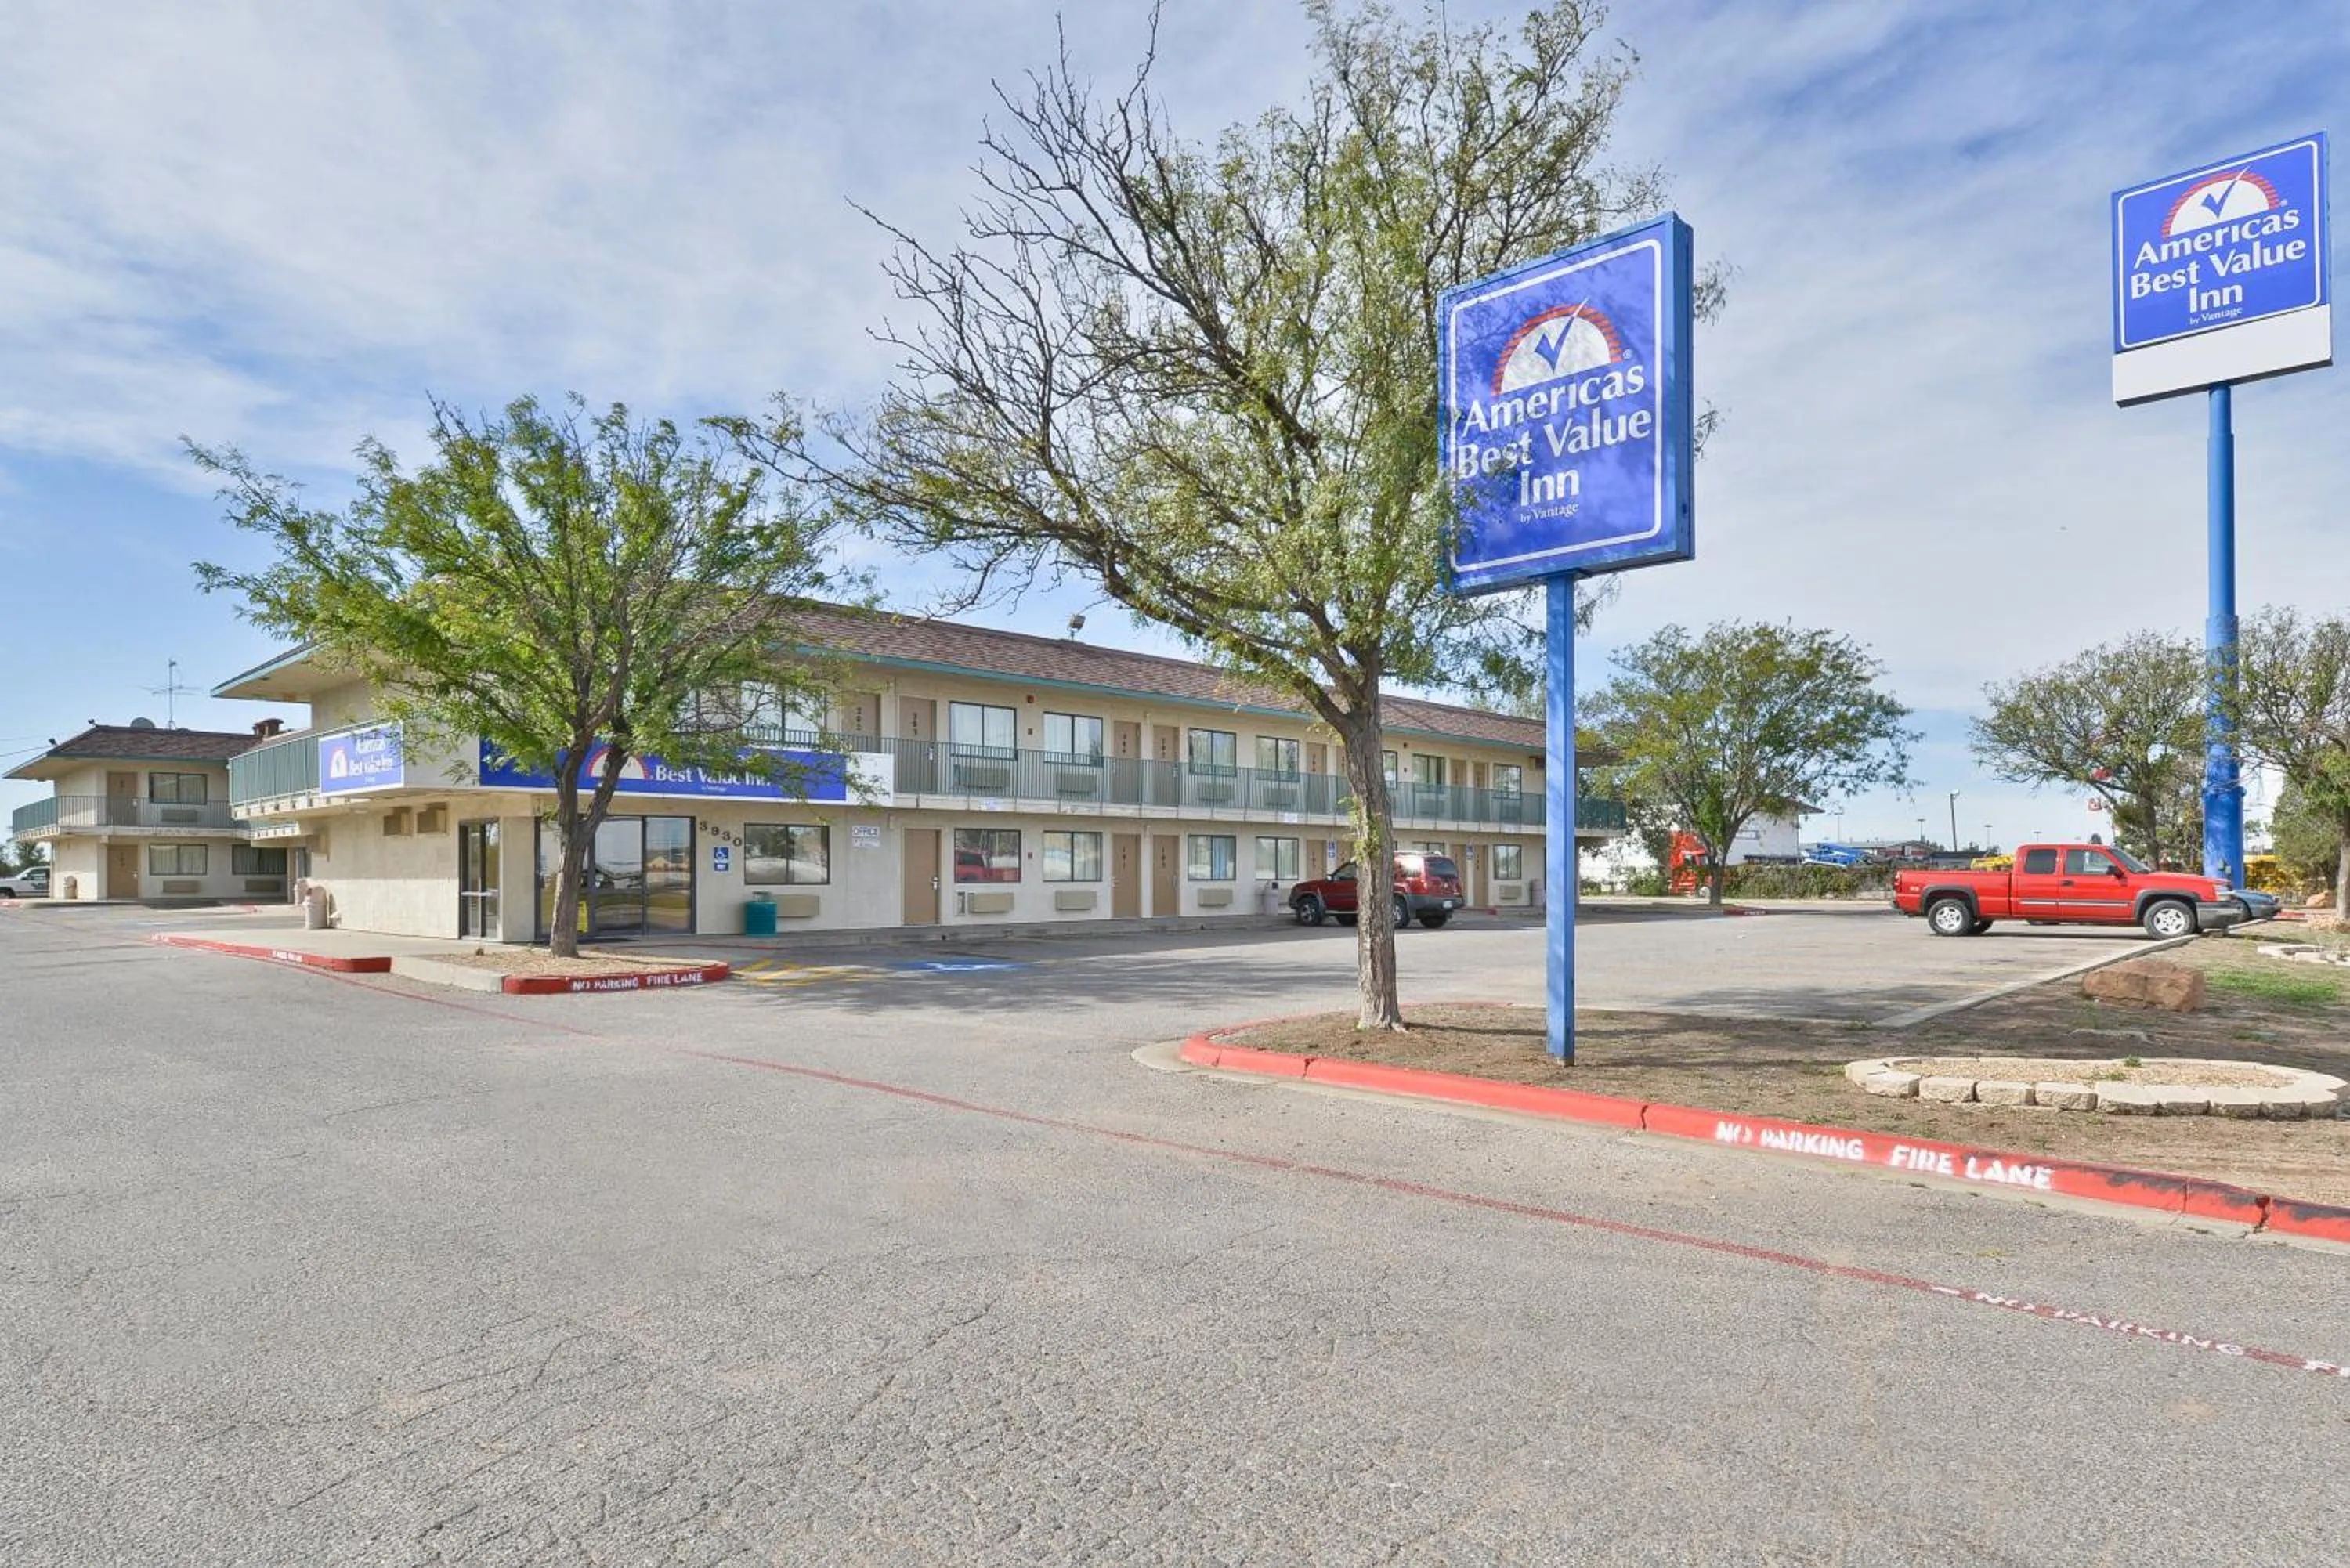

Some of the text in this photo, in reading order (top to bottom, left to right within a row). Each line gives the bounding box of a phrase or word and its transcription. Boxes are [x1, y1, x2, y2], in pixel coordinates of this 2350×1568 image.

[2133, 208, 2300, 269] Americas
[2130, 238, 2306, 300] Best Value
[2189, 284, 2243, 313] Inn
[2201, 307, 2243, 321] Vantage
[1461, 363, 1646, 438] Americas
[1458, 407, 1653, 481] Best Value
[1520, 468, 1580, 508] Inn
[1520, 504, 1580, 524] by Vantage
[656, 764, 692, 782] Best
[594, 977, 639, 989] PARKING
[1716, 1121, 2053, 1190] NO PARKING FIRE LANE
